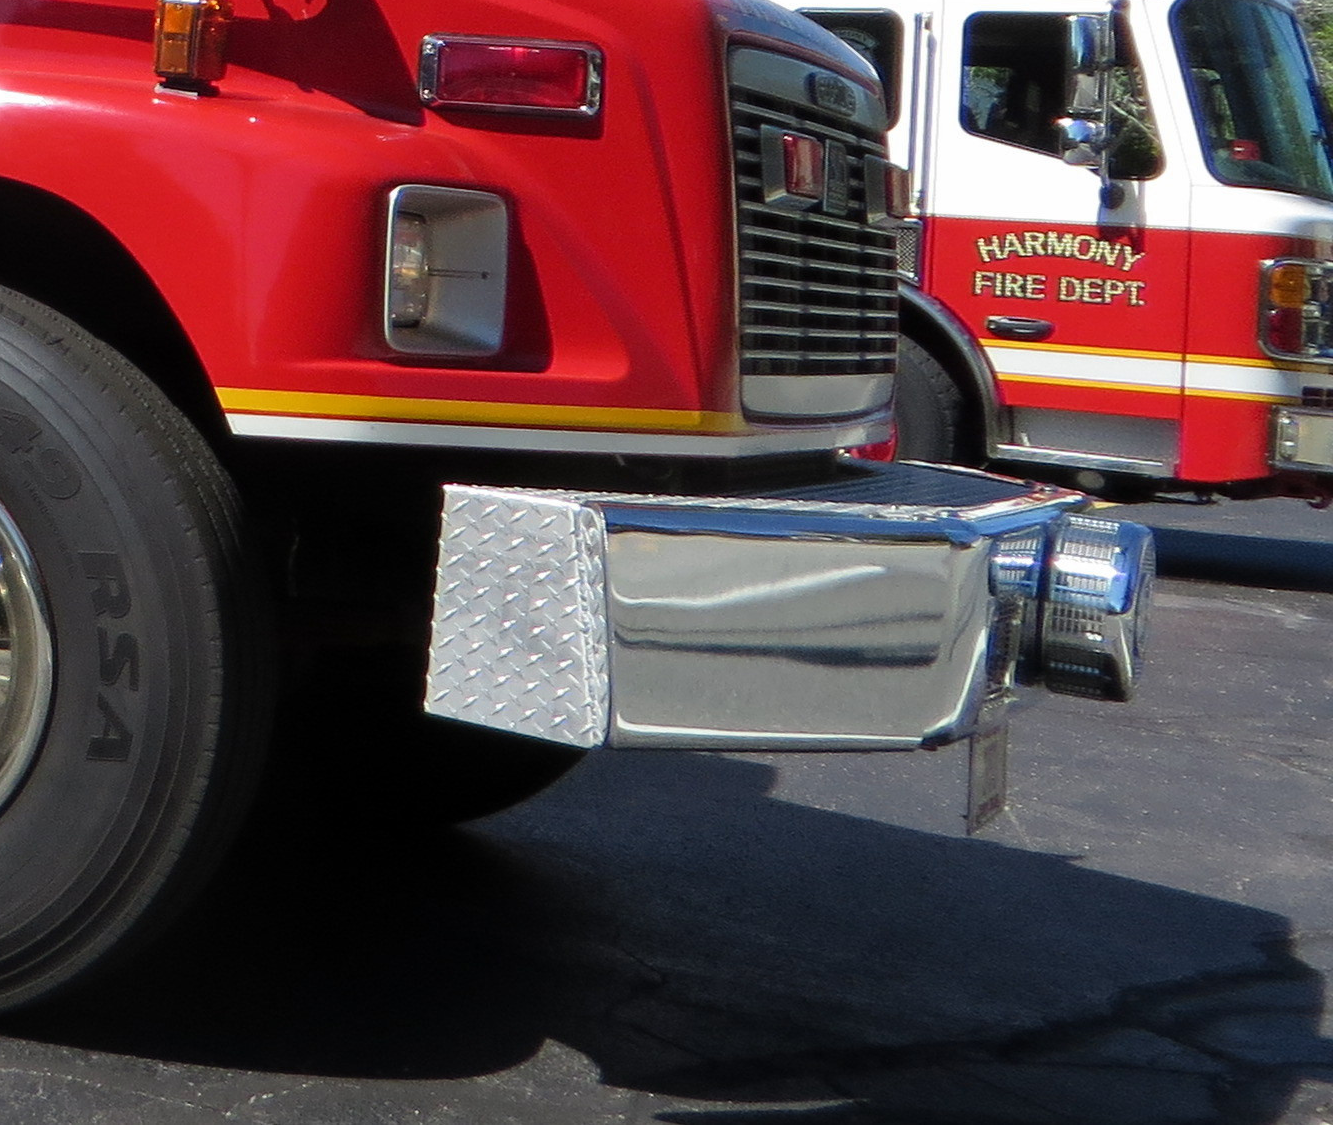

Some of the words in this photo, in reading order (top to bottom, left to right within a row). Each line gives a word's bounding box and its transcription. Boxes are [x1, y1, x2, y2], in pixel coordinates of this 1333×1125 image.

[976, 230, 1146, 272] HARMONY
[973, 271, 1046, 300] FIRE
[1058, 276, 1146, 306] DEPT.
[76, 549, 139, 763] RSA
